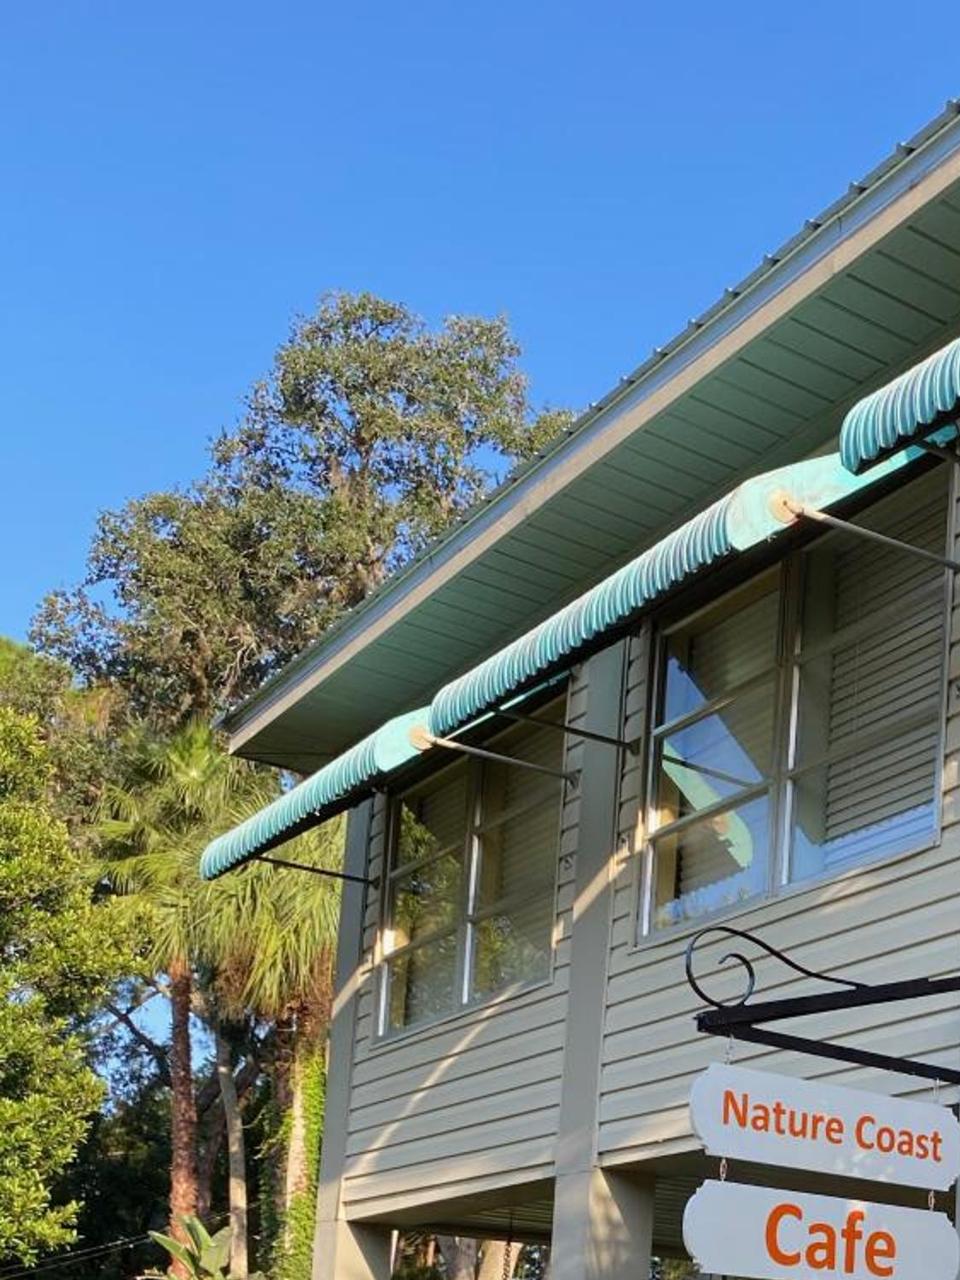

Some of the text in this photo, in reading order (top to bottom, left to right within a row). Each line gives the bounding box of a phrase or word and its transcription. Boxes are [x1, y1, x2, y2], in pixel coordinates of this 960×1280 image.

[722, 1089, 942, 1162] Nature Coast
[765, 1203, 897, 1277] Cafe
